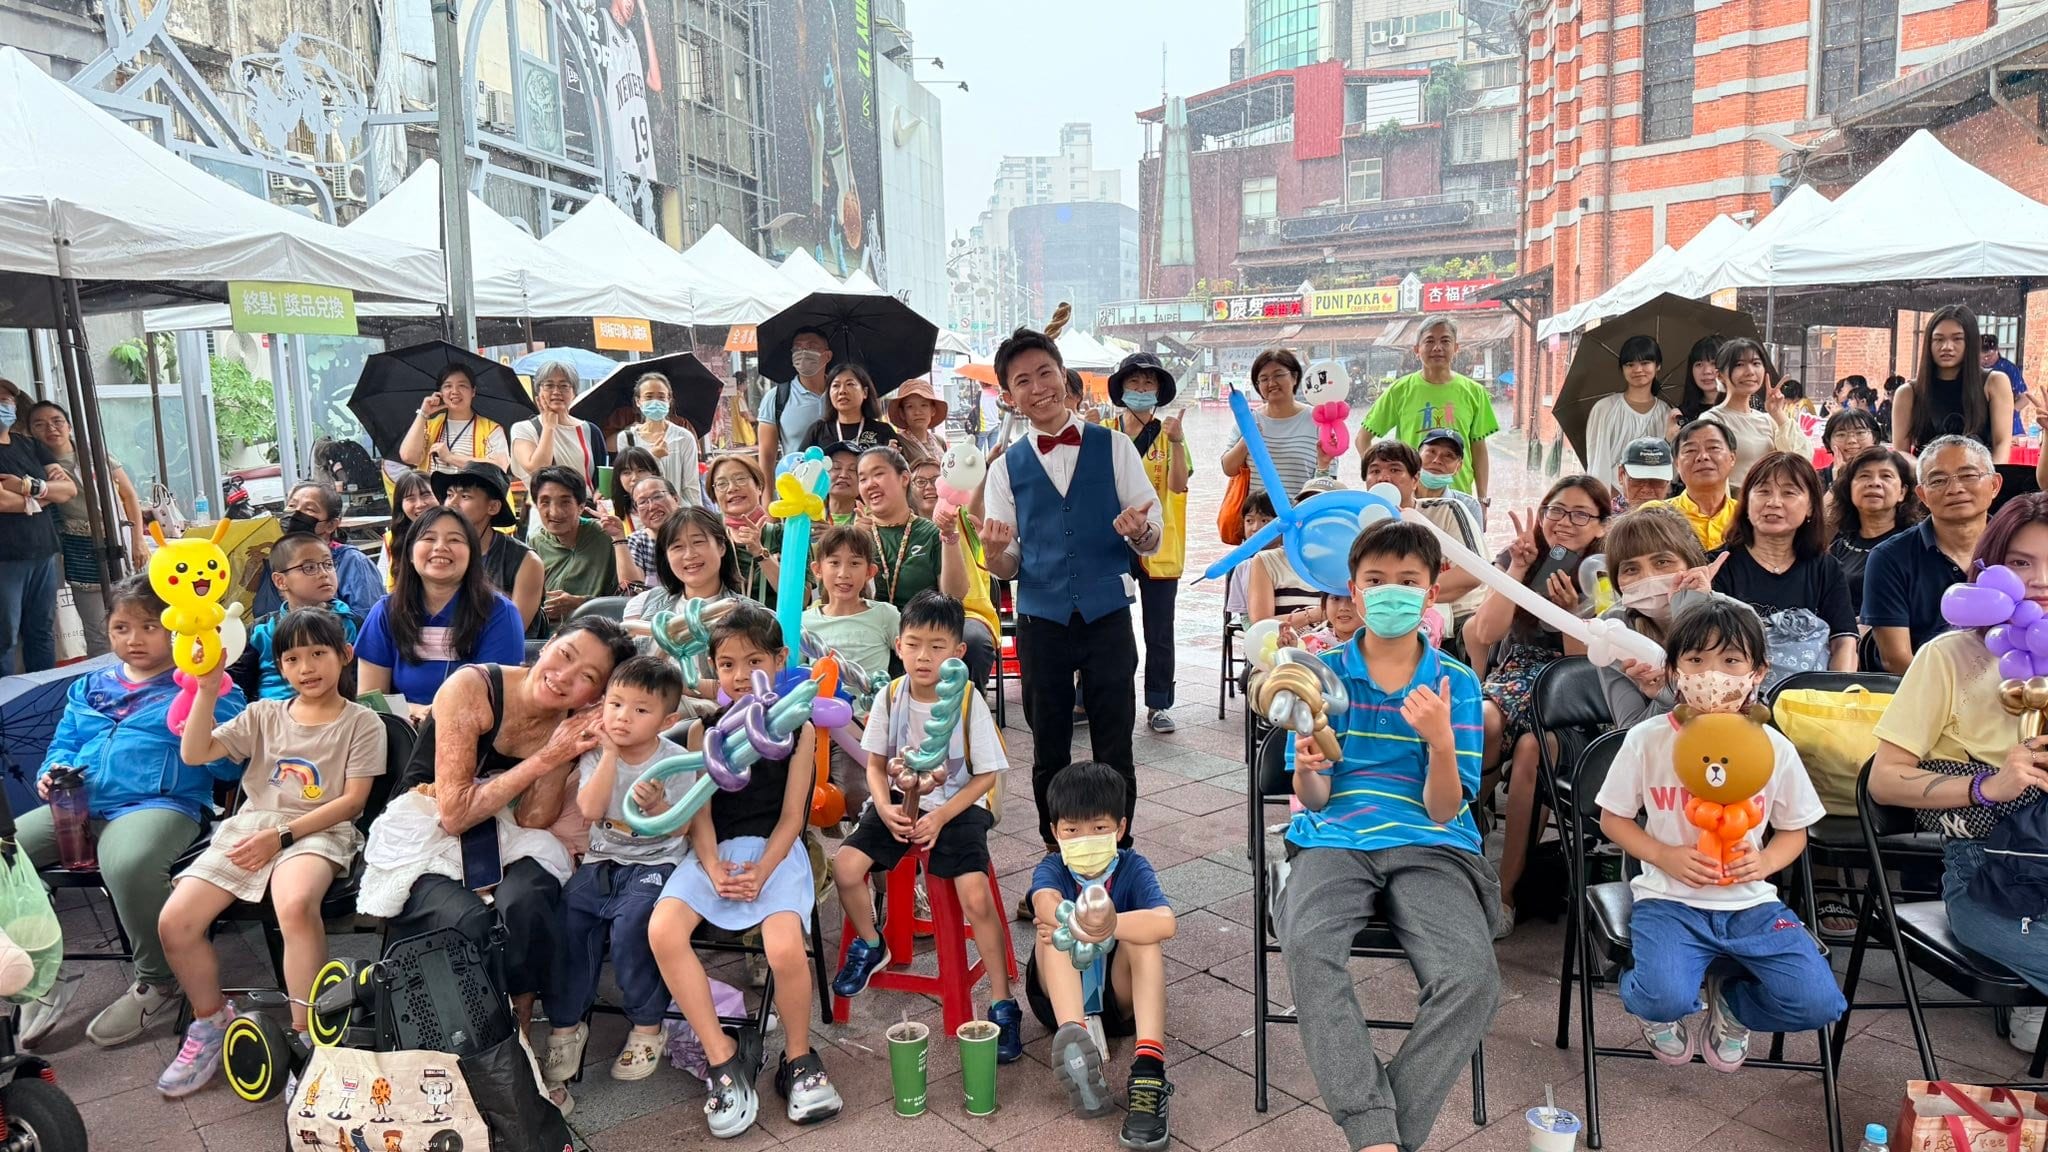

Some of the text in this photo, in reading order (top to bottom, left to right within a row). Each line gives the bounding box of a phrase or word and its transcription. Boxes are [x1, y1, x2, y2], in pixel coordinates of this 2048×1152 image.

[857, 47, 871, 79] 12
[631, 115, 649, 163] 19
[243, 290, 345, 319] 終點 獎品兌換
[1315, 295, 1343, 310] PUNI
[1346, 292, 1381, 309] POKA
